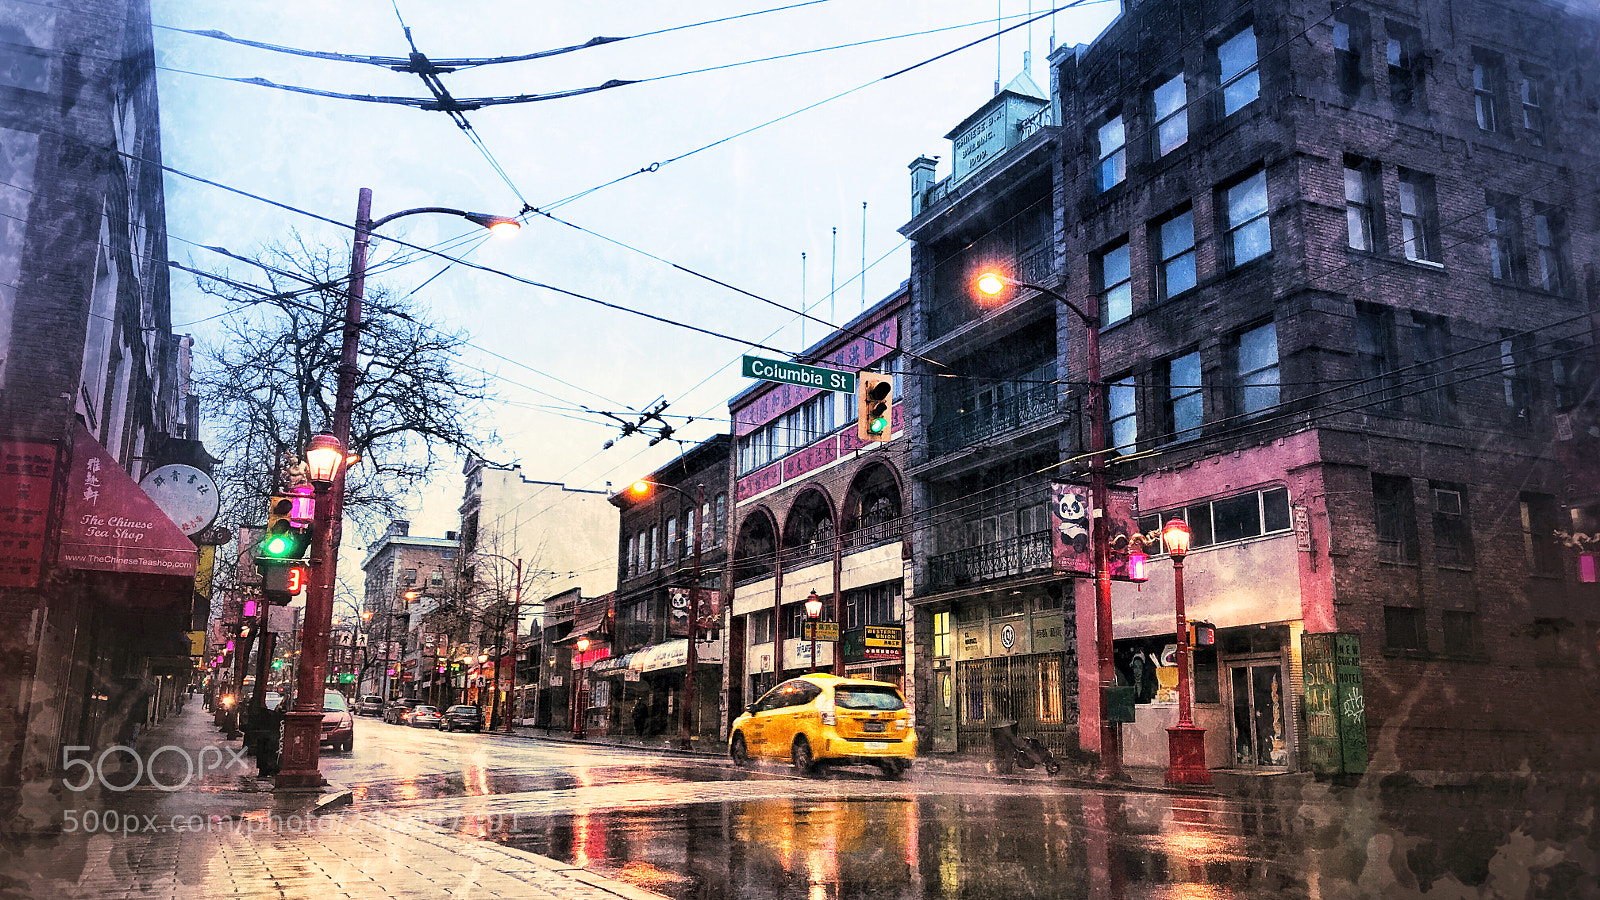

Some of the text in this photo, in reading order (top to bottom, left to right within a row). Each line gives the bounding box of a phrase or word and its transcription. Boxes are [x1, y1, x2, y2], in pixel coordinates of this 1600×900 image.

[751, 360, 847, 389] Columbia St
[80, 514, 153, 530] The Chinese
[85, 526, 144, 543] Tea Shop
[1339, 644, 1359, 654] NEW
[1307, 662, 1335, 686] SUN
[1339, 672, 1361, 684] HOTEL
